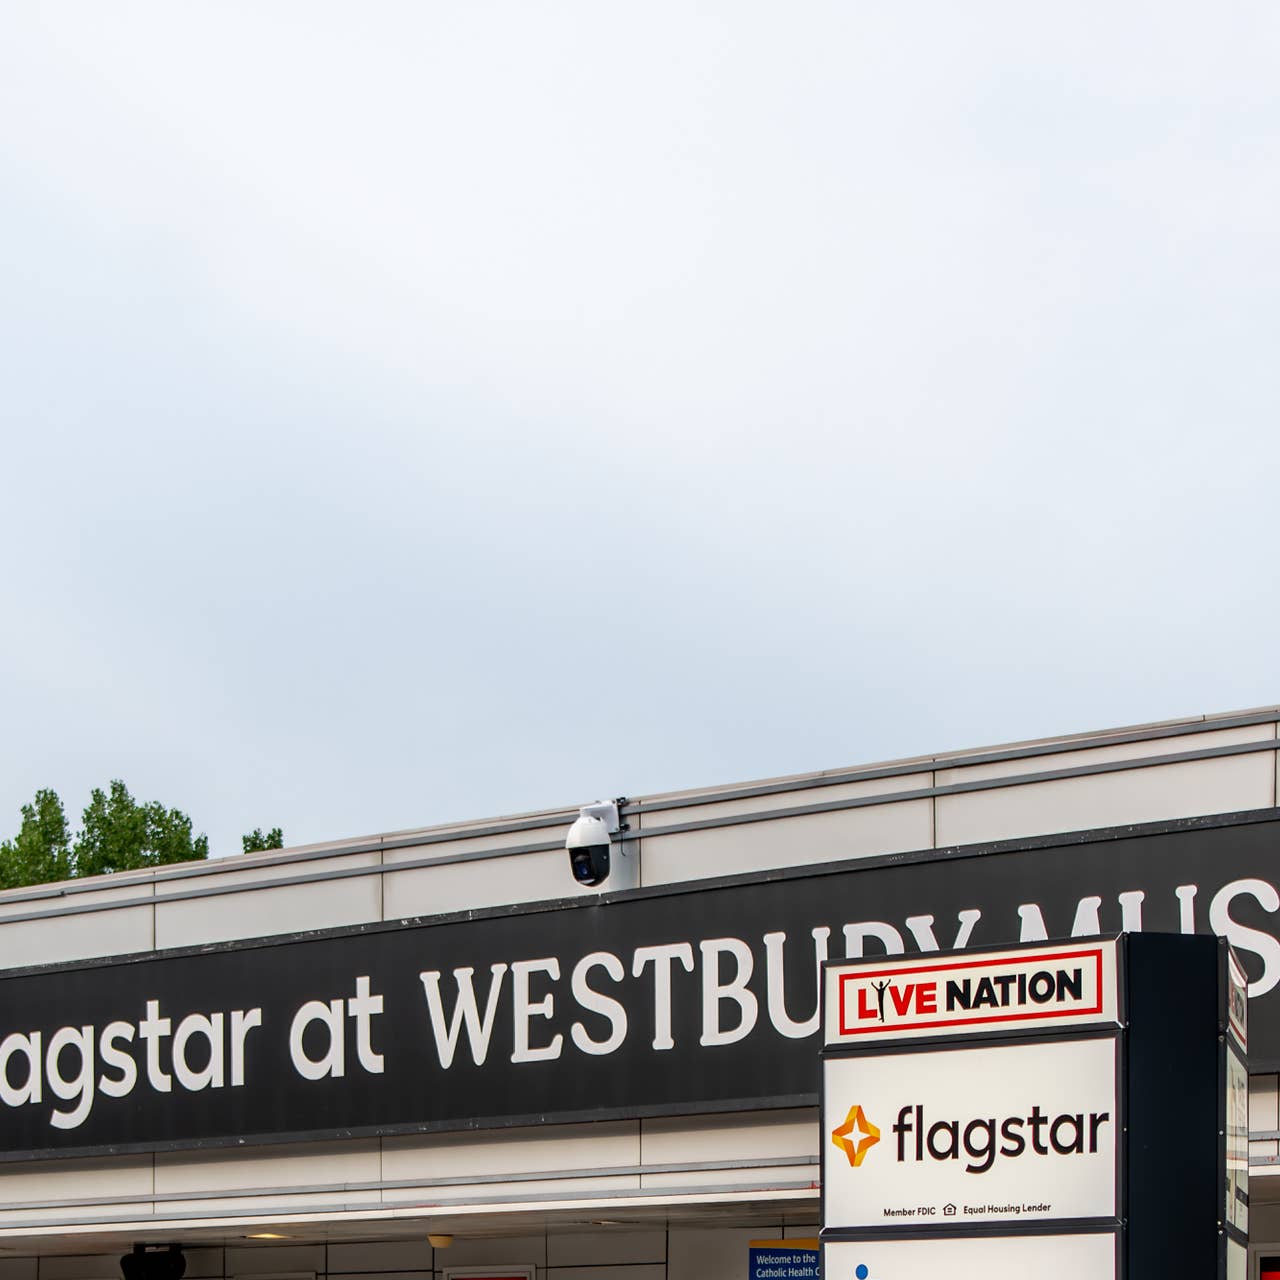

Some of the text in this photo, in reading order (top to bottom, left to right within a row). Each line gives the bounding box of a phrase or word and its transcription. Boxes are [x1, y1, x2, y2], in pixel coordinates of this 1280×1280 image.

[858, 968, 1082, 1022] LIVE NATION
[290, 976, 384, 1080] at
[892, 1105, 1110, 1174] flagstar
[883, 1203, 1051, 1217] Member FDIC Equal Housing Lender
[756, 1254, 816, 1264] Welcome to the
[756, 1268, 786, 1278] Catholic
[788, 1267, 814, 1277] Health
